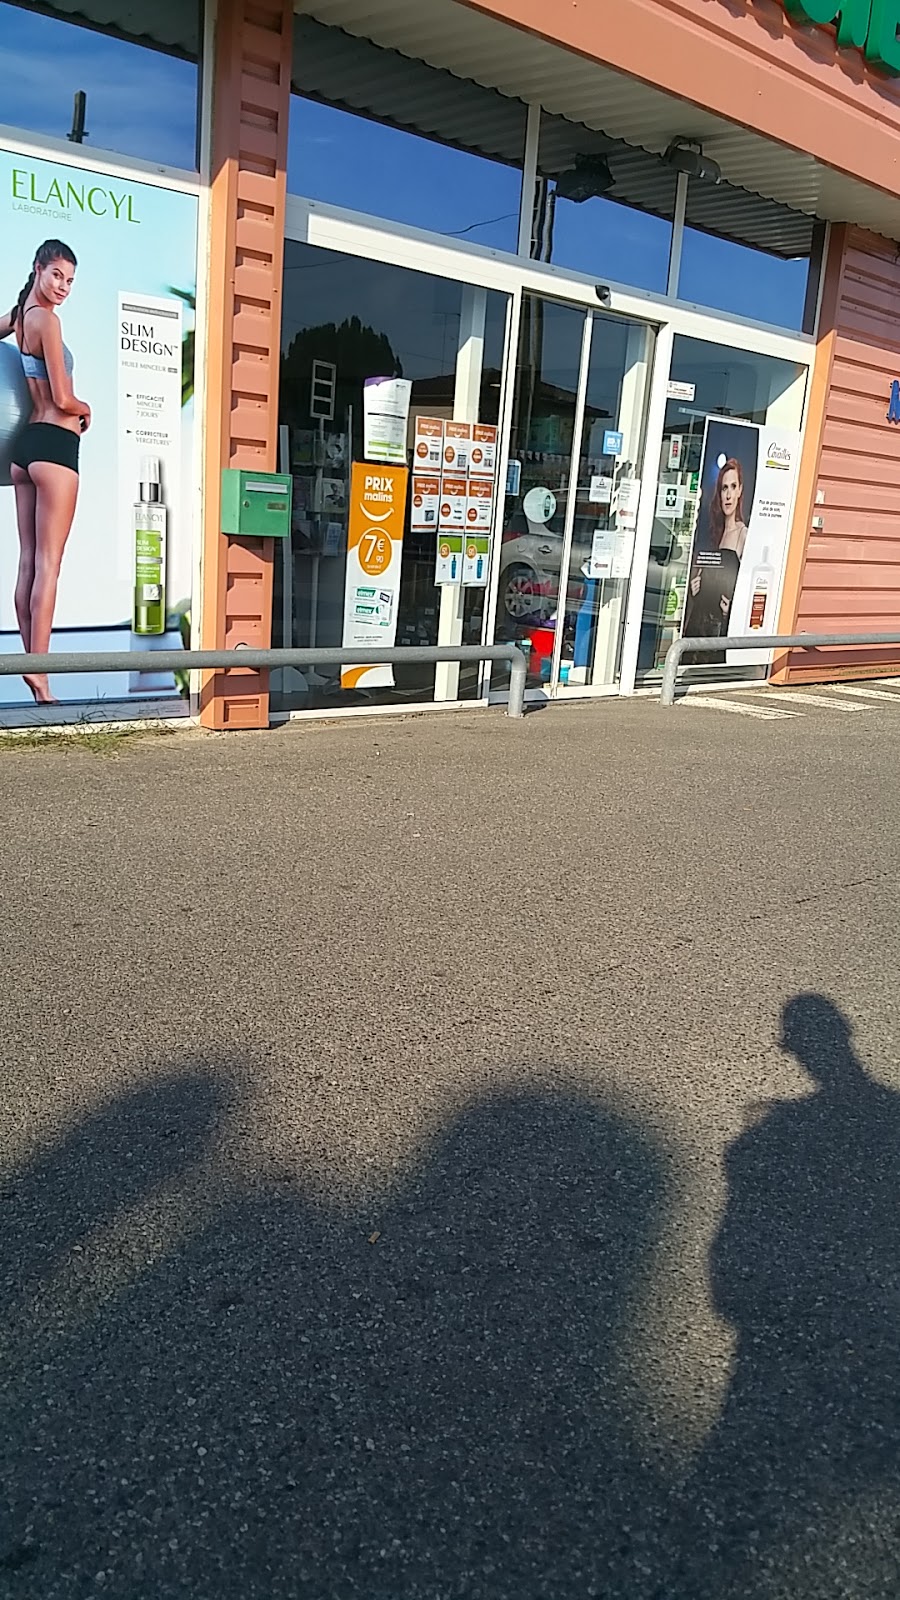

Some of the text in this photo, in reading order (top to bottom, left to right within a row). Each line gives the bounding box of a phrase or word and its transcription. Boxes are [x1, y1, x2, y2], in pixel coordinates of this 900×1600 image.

[12, 168, 141, 223] ELANCYL
[12, 203, 72, 222] LABORATOIRE
[121, 321, 154, 339] SLIM
[364, 476, 394, 493] PRIX
[364, 492, 393, 503] malins
